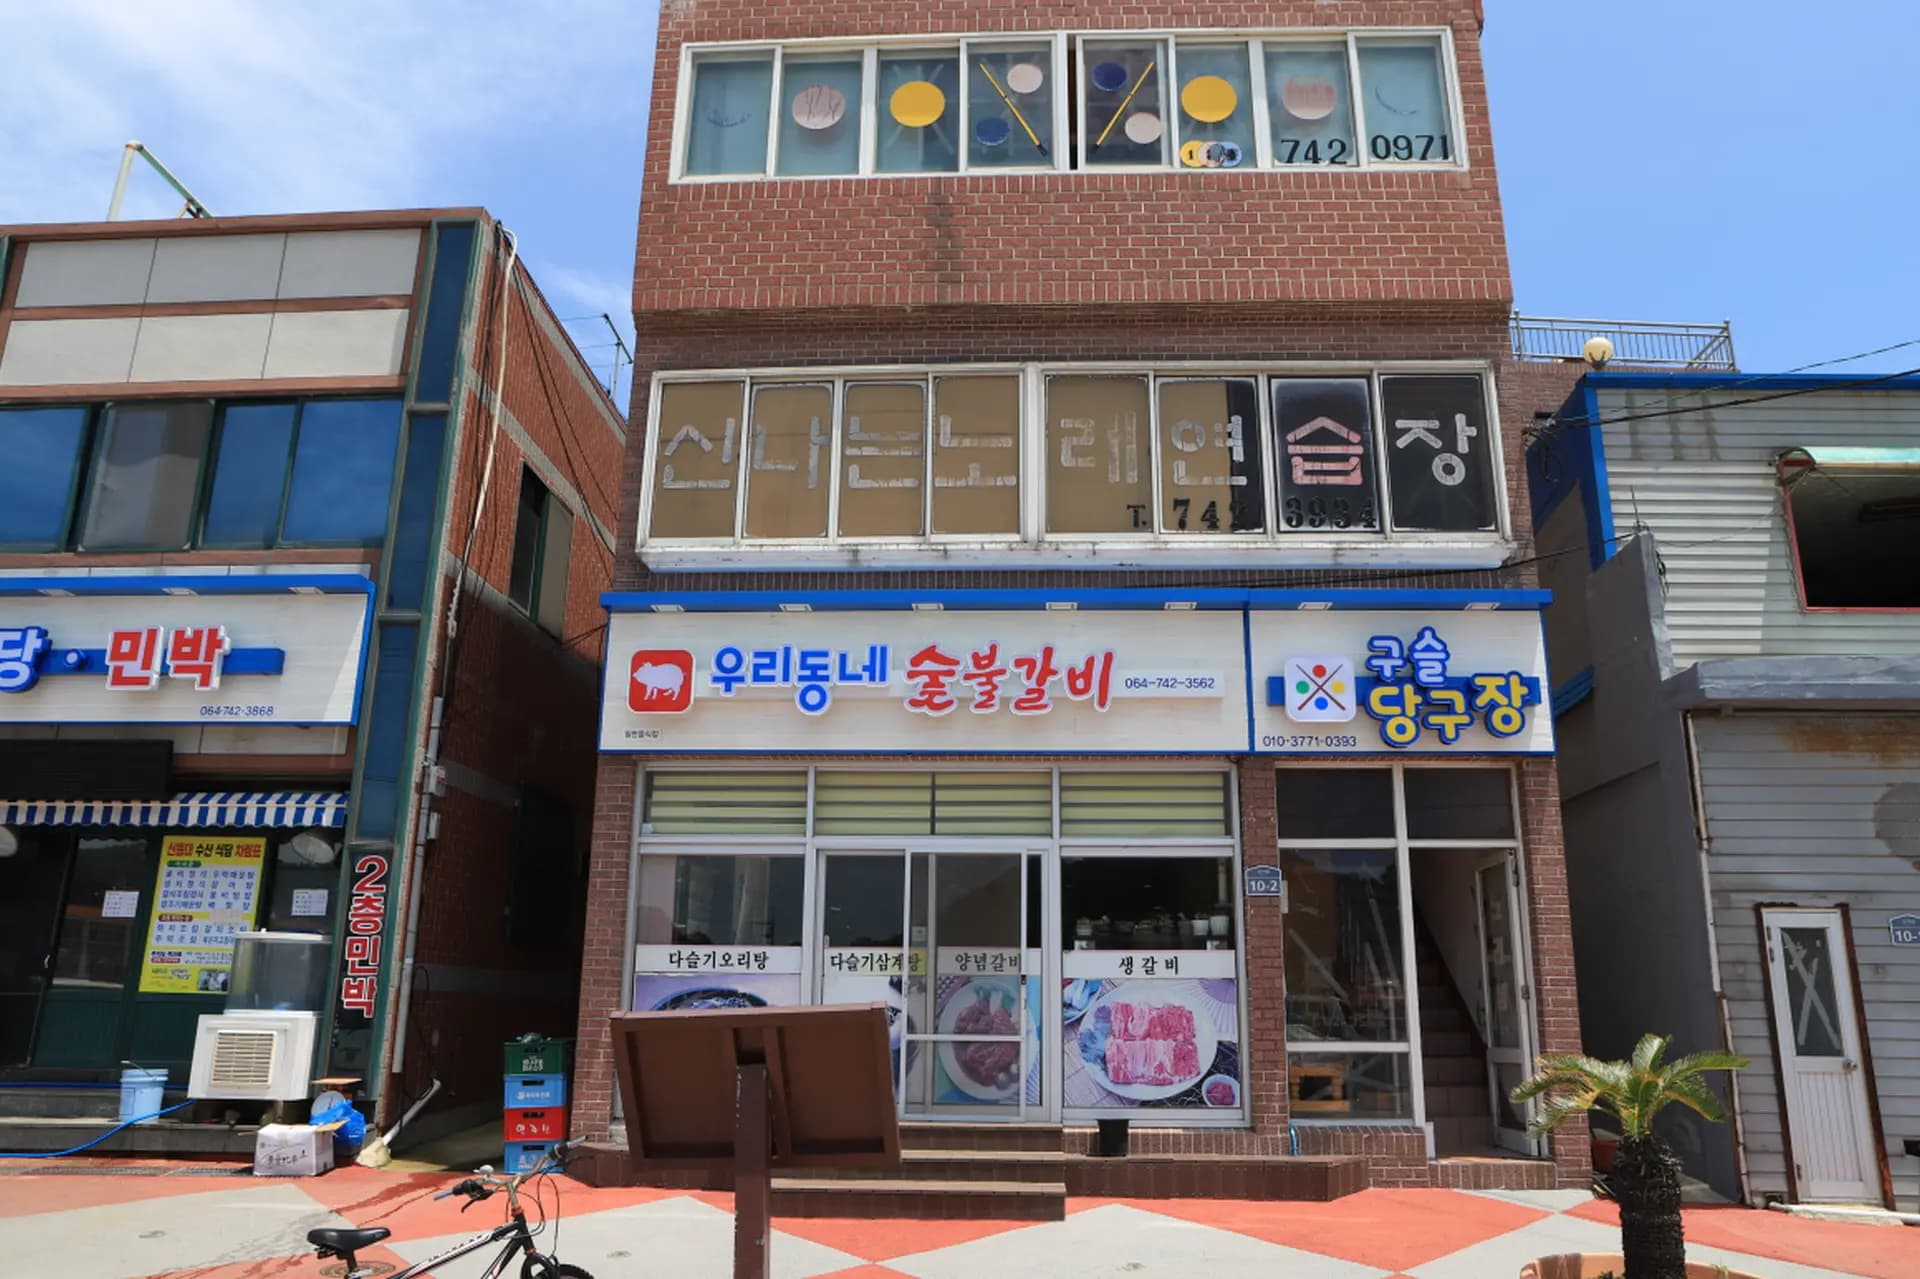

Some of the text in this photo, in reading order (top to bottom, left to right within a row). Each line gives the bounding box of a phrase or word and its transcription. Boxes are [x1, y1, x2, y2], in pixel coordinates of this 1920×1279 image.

[1281, 134, 1449, 164] 742 0971
[107, 625, 230, 690] 민박
[1365, 627, 1449, 687] 구슬
[711, 643, 1114, 712] 우리동네 숯불갈비
[1124, 676, 1215, 690] 064-742-3562
[1366, 672, 1530, 747] 당구장
[1262, 735, 1357, 747] 010-3771-0393
[1250, 879, 1278, 892] 10-2
[342, 855, 388, 1018] 2층민박
[1895, 929, 1920, 943] 10-
[668, 950, 770, 970] 다슬기오리탕
[955, 952, 1022, 972] 양념갈비
